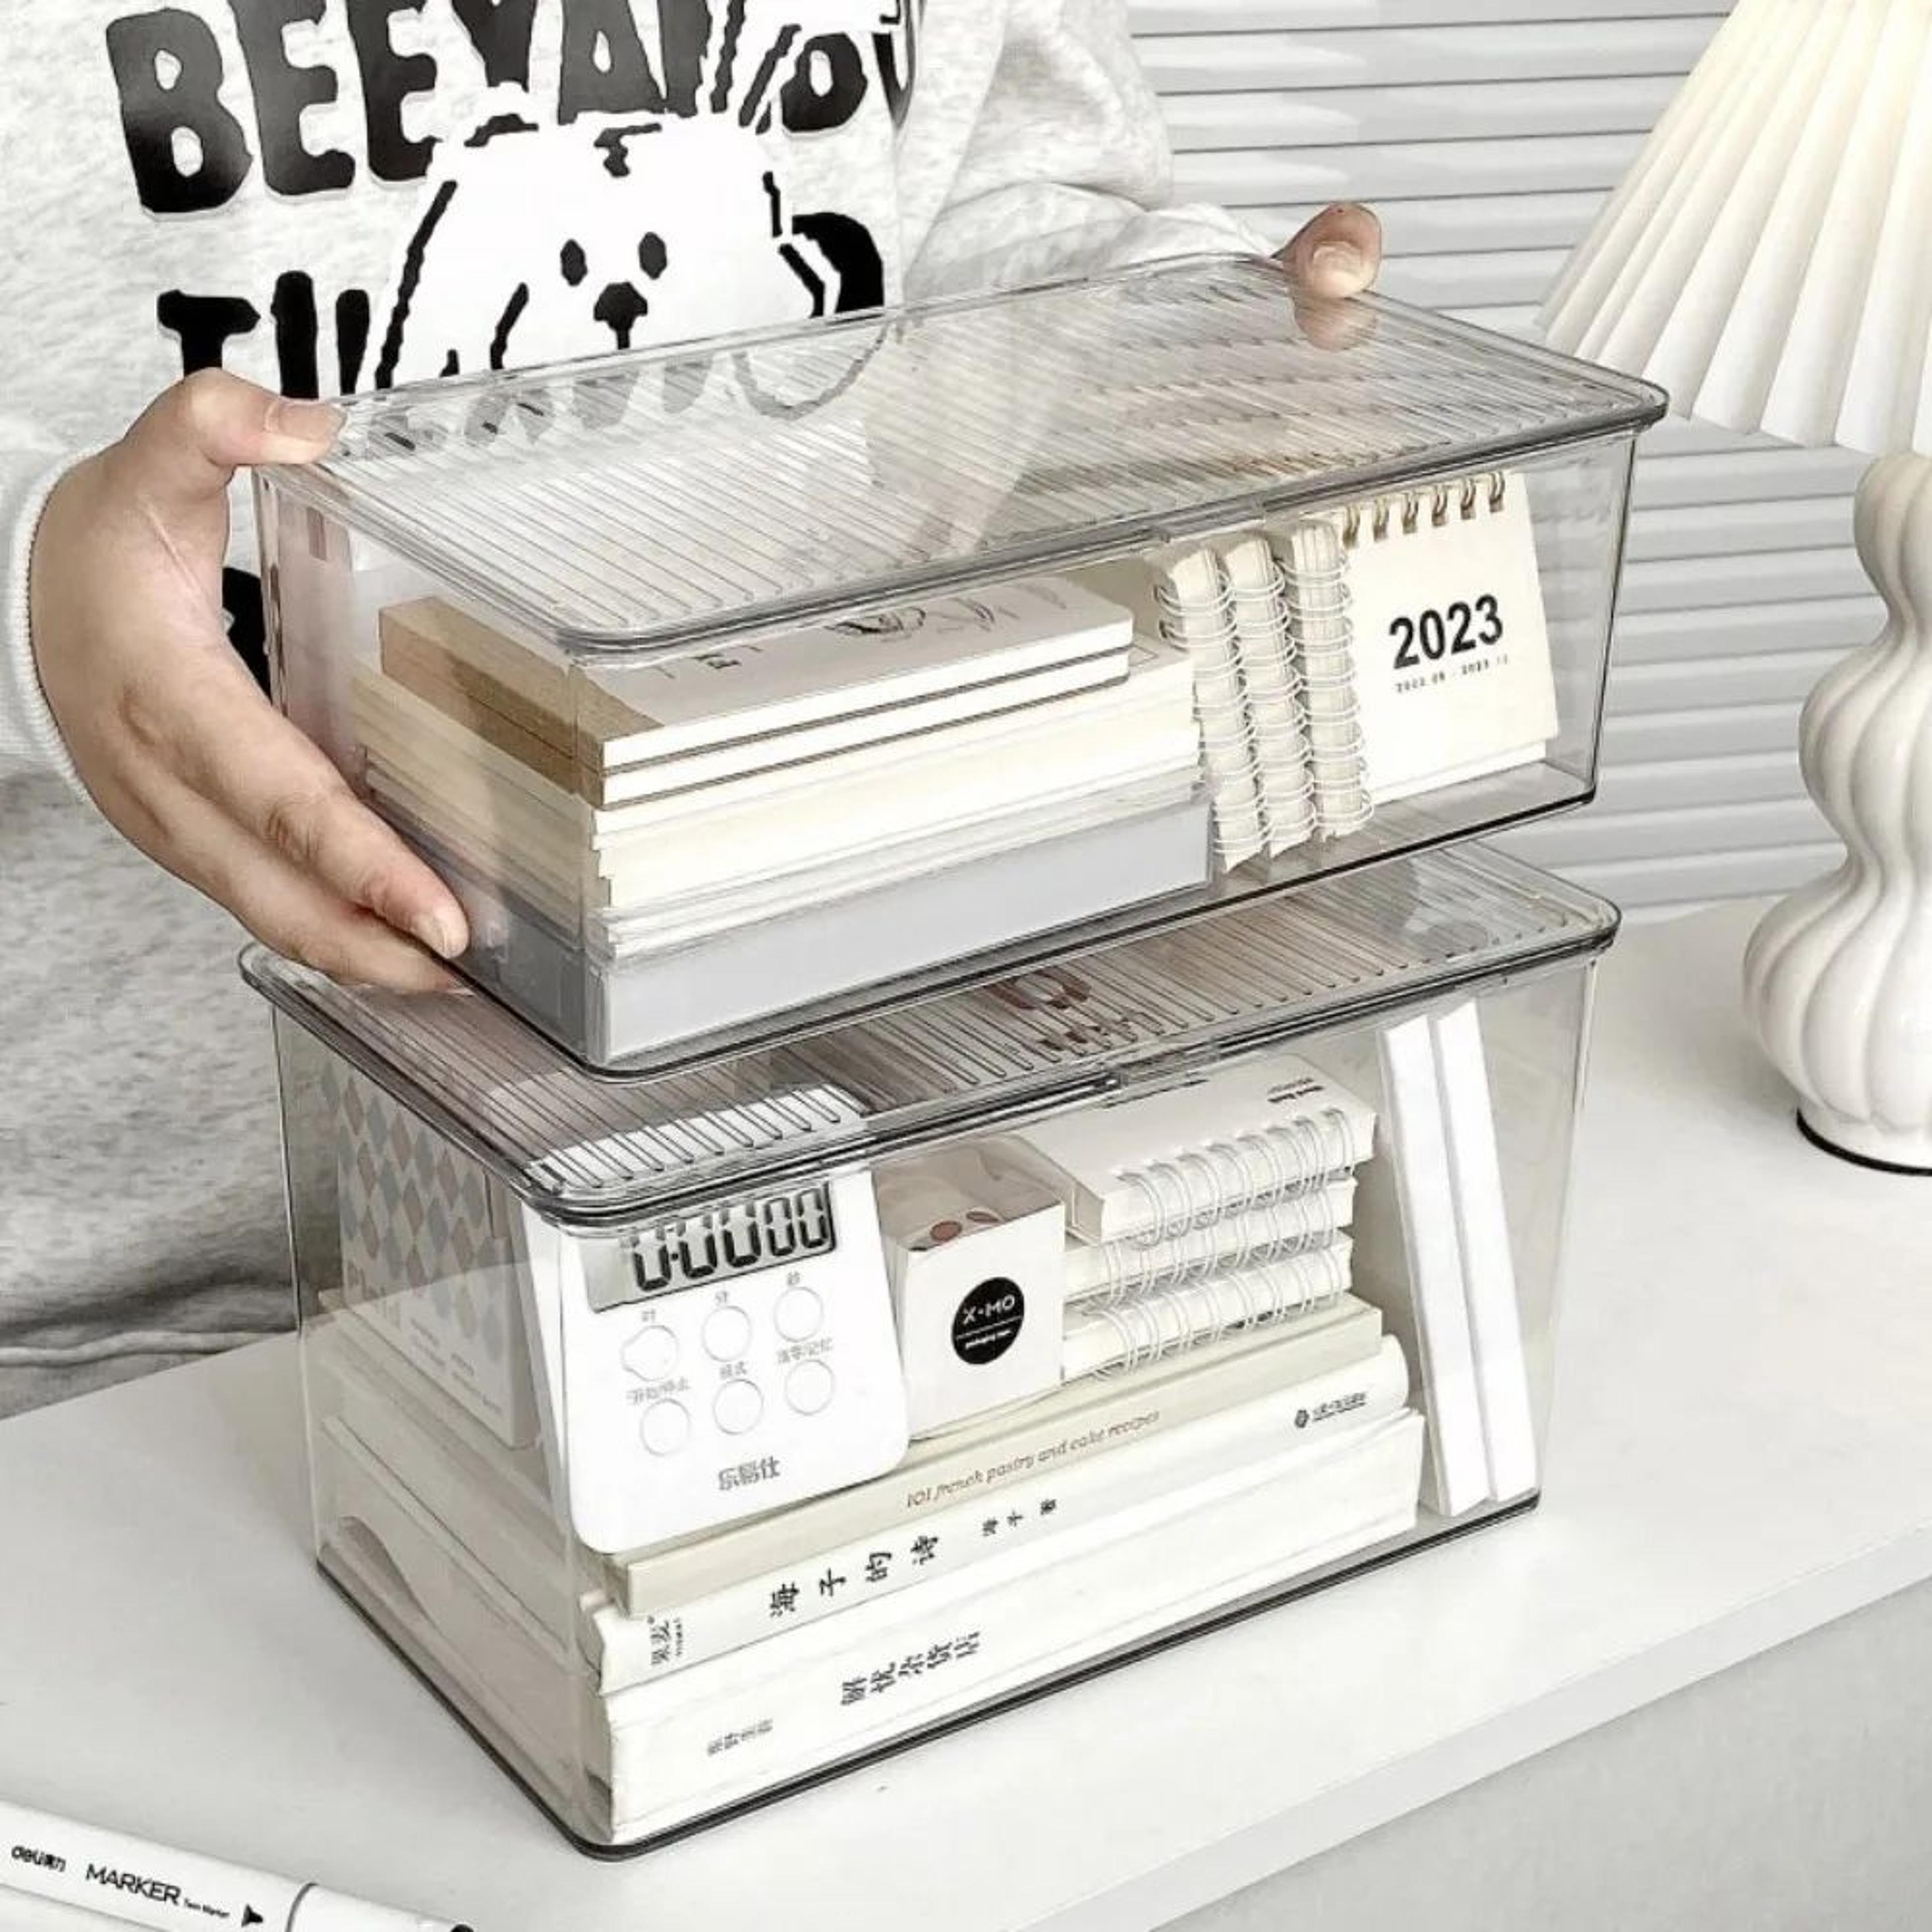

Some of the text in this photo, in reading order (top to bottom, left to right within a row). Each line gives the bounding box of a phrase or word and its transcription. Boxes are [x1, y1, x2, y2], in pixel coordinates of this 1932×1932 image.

[1389, 594, 1503, 669] 2023
[934, 1469, 984, 1501] french
[986, 1454, 1035, 1484] pastry
[1038, 1440, 1067, 1462] and
[1070, 1429, 1105, 1451] cake
[1108, 1410, 1160, 1438] recipes
[770, 1536, 939, 1617] 海子的诗
[86, 1864, 181, 1905] MARKER
